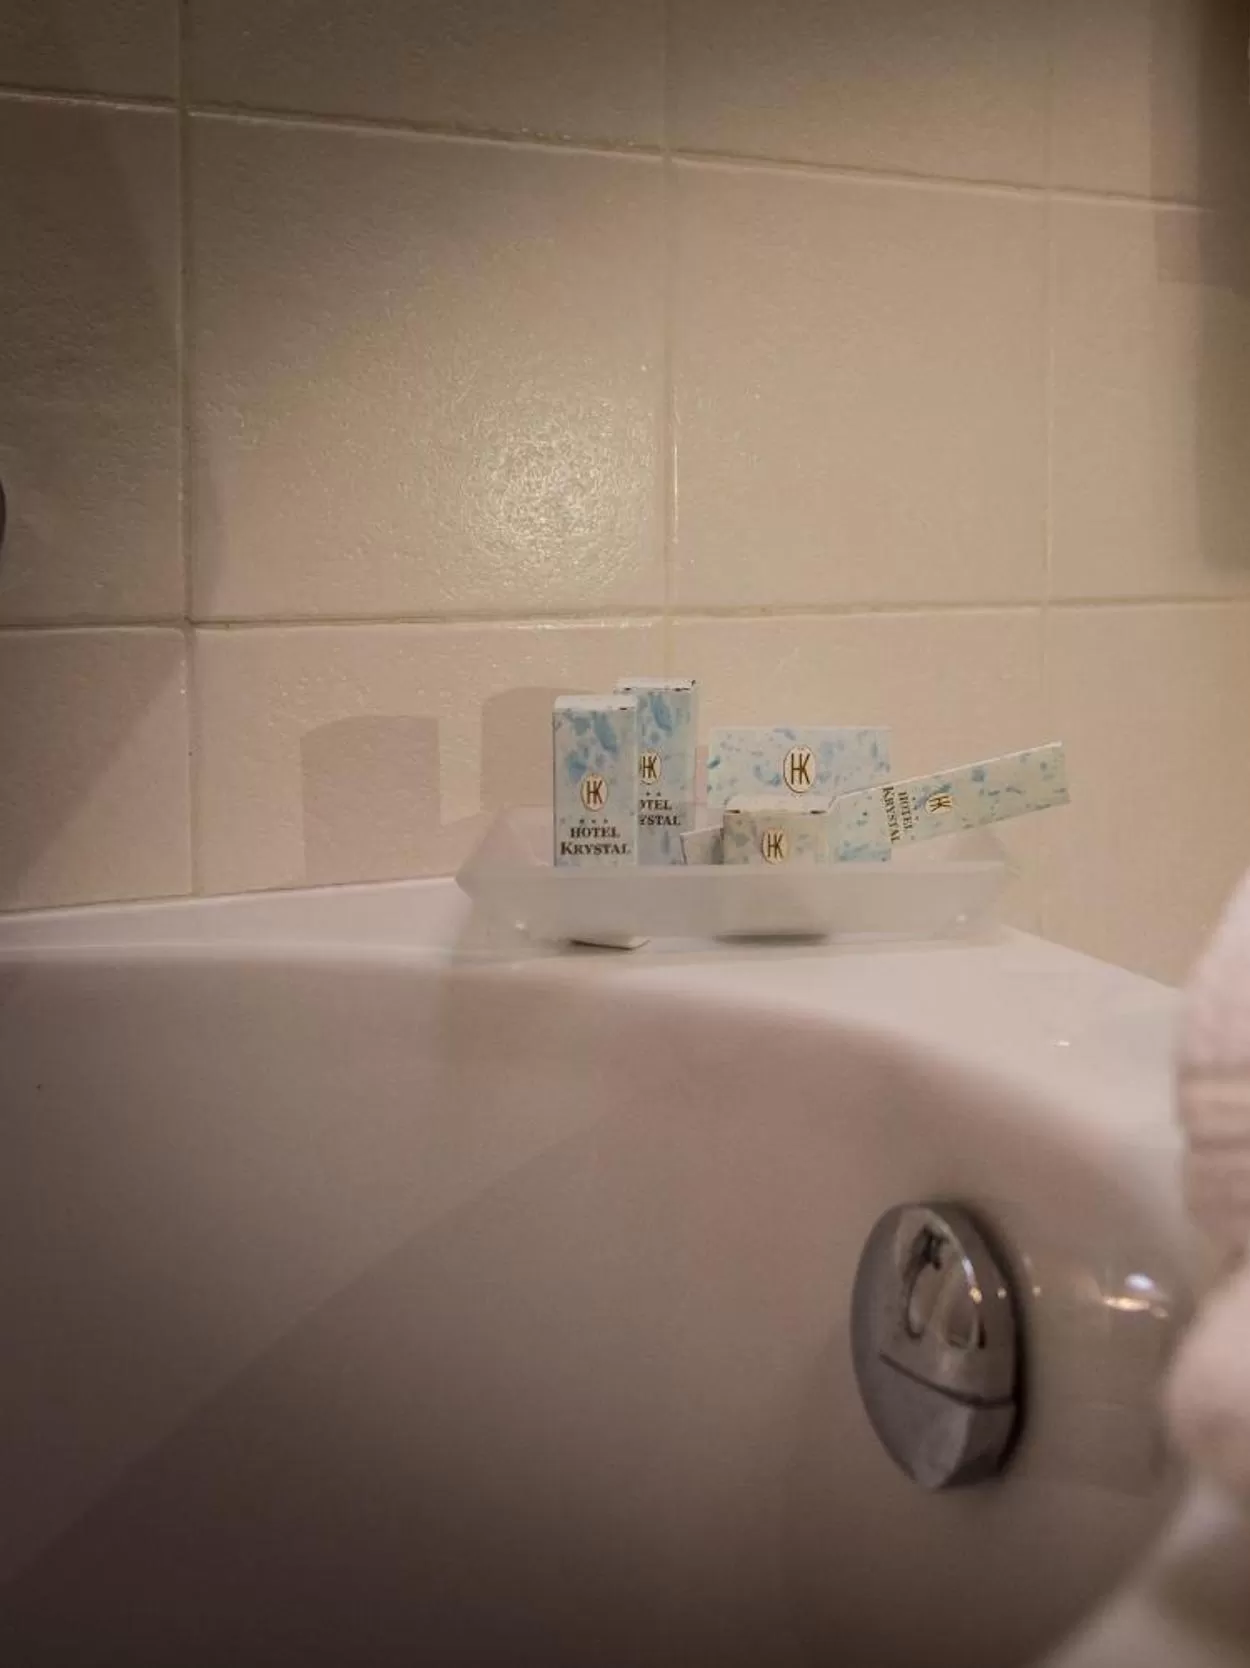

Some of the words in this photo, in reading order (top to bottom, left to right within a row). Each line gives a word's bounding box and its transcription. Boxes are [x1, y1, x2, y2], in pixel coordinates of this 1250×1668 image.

[791, 752, 811, 786] HK
[586, 780, 603, 805] HK
[882, 786, 901, 845] KRYSTAL
[897, 791, 913, 832] HOTEL
[570, 826, 621, 839] HOTEL
[767, 832, 785, 859] HK
[560, 841, 632, 856] KRYSTAL
